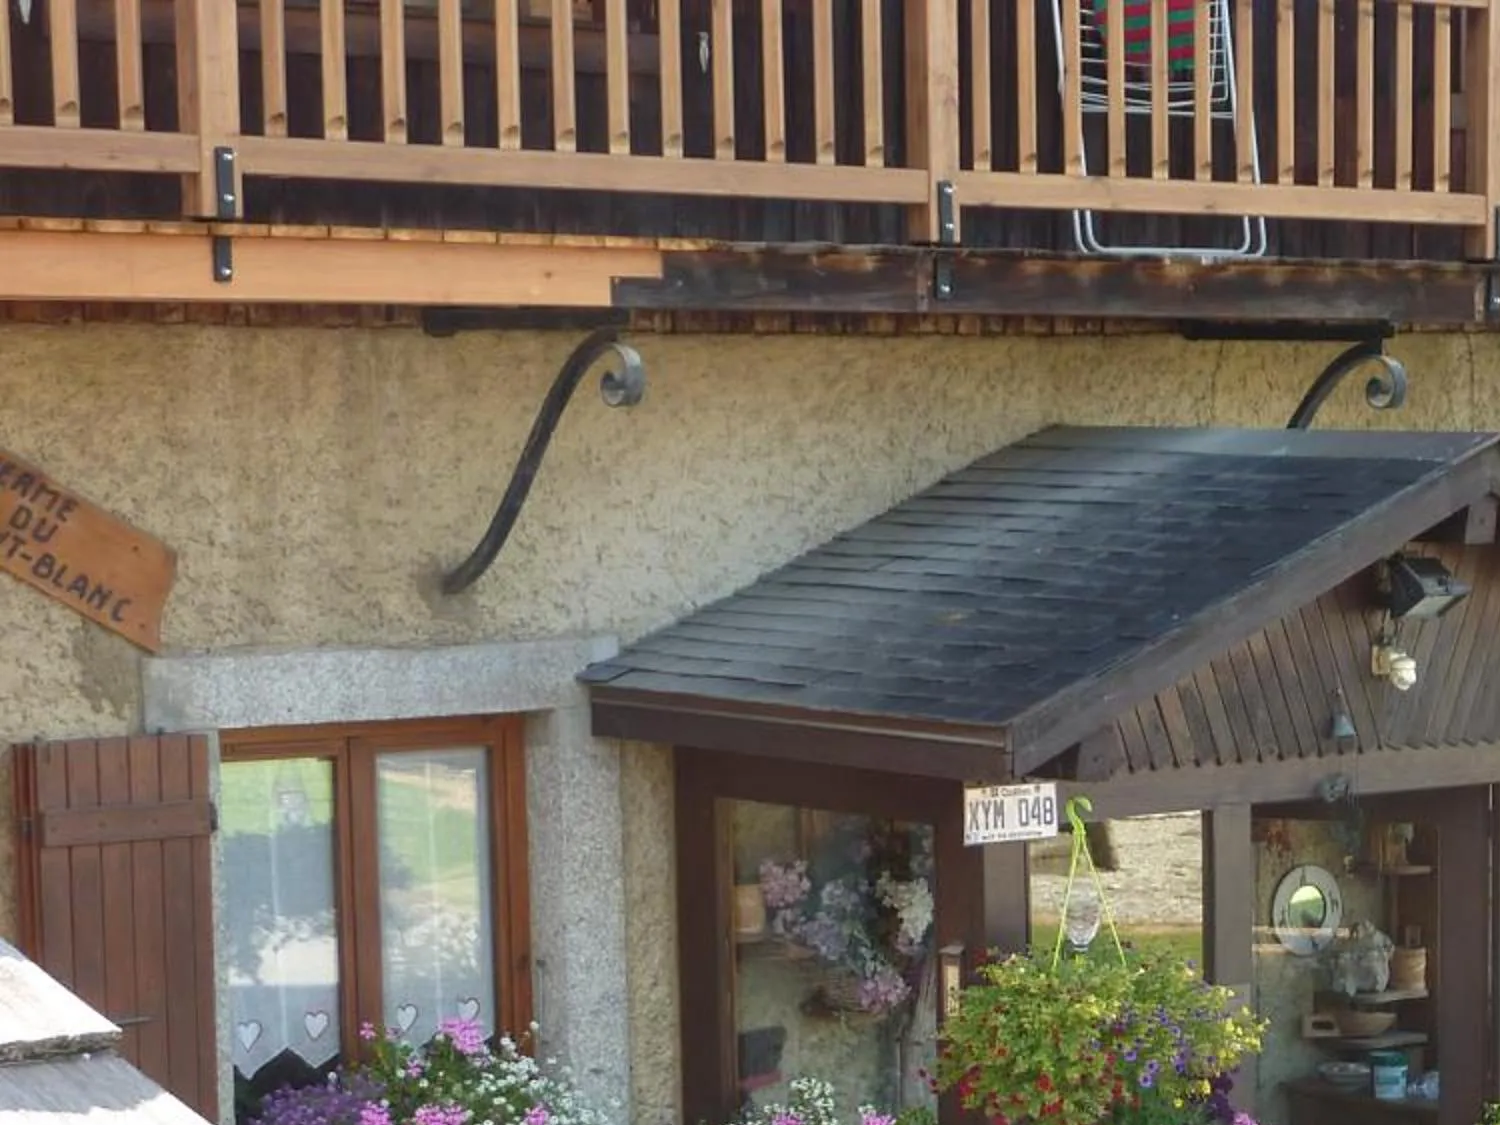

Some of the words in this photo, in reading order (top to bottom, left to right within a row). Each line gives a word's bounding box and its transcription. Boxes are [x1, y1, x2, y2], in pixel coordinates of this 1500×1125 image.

[9, 505, 59, 543] DU
[969, 799, 1005, 832] XYM
[1018, 796, 1053, 827] 048
